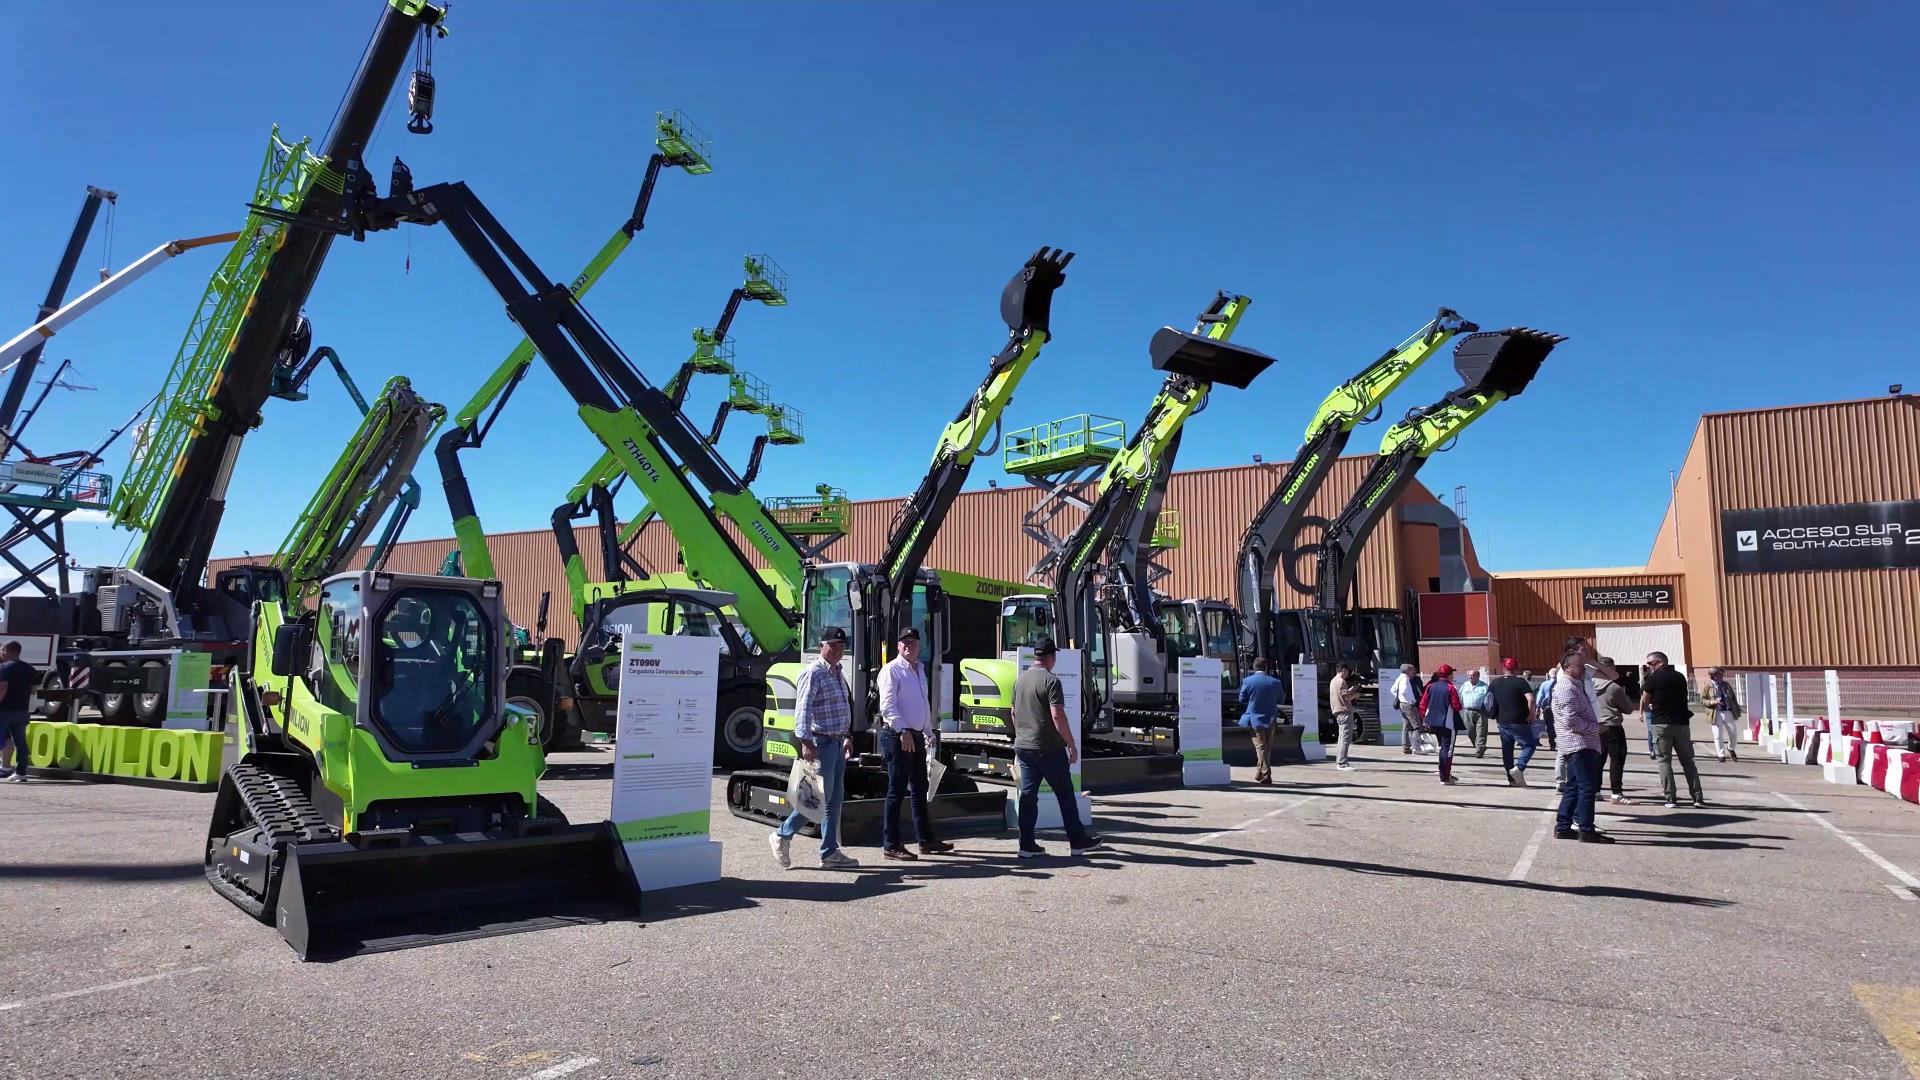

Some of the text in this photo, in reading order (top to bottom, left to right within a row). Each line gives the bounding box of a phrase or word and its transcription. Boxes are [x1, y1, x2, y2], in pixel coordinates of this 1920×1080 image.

[16, 468, 58, 479] SUNWARD
[622, 437, 660, 483] ZTH4014
[1283, 453, 1319, 505] ZOOMLION
[1365, 470, 1396, 508] ZOOMLION
[752, 519, 780, 552] ZTH4018
[889, 519, 925, 579] ZOOMLION
[1071, 526, 1103, 573] ZOOMLION
[1762, 525, 1850, 541] ACCESO
[1855, 523, 1902, 536] SUR
[1773, 537, 1893, 550] SOUTH ACCESS
[1586, 590, 1669, 604] ACCESO SUR 2
[629, 658, 661, 667] ZT090V
[18, 721, 211, 784] OOMLION
